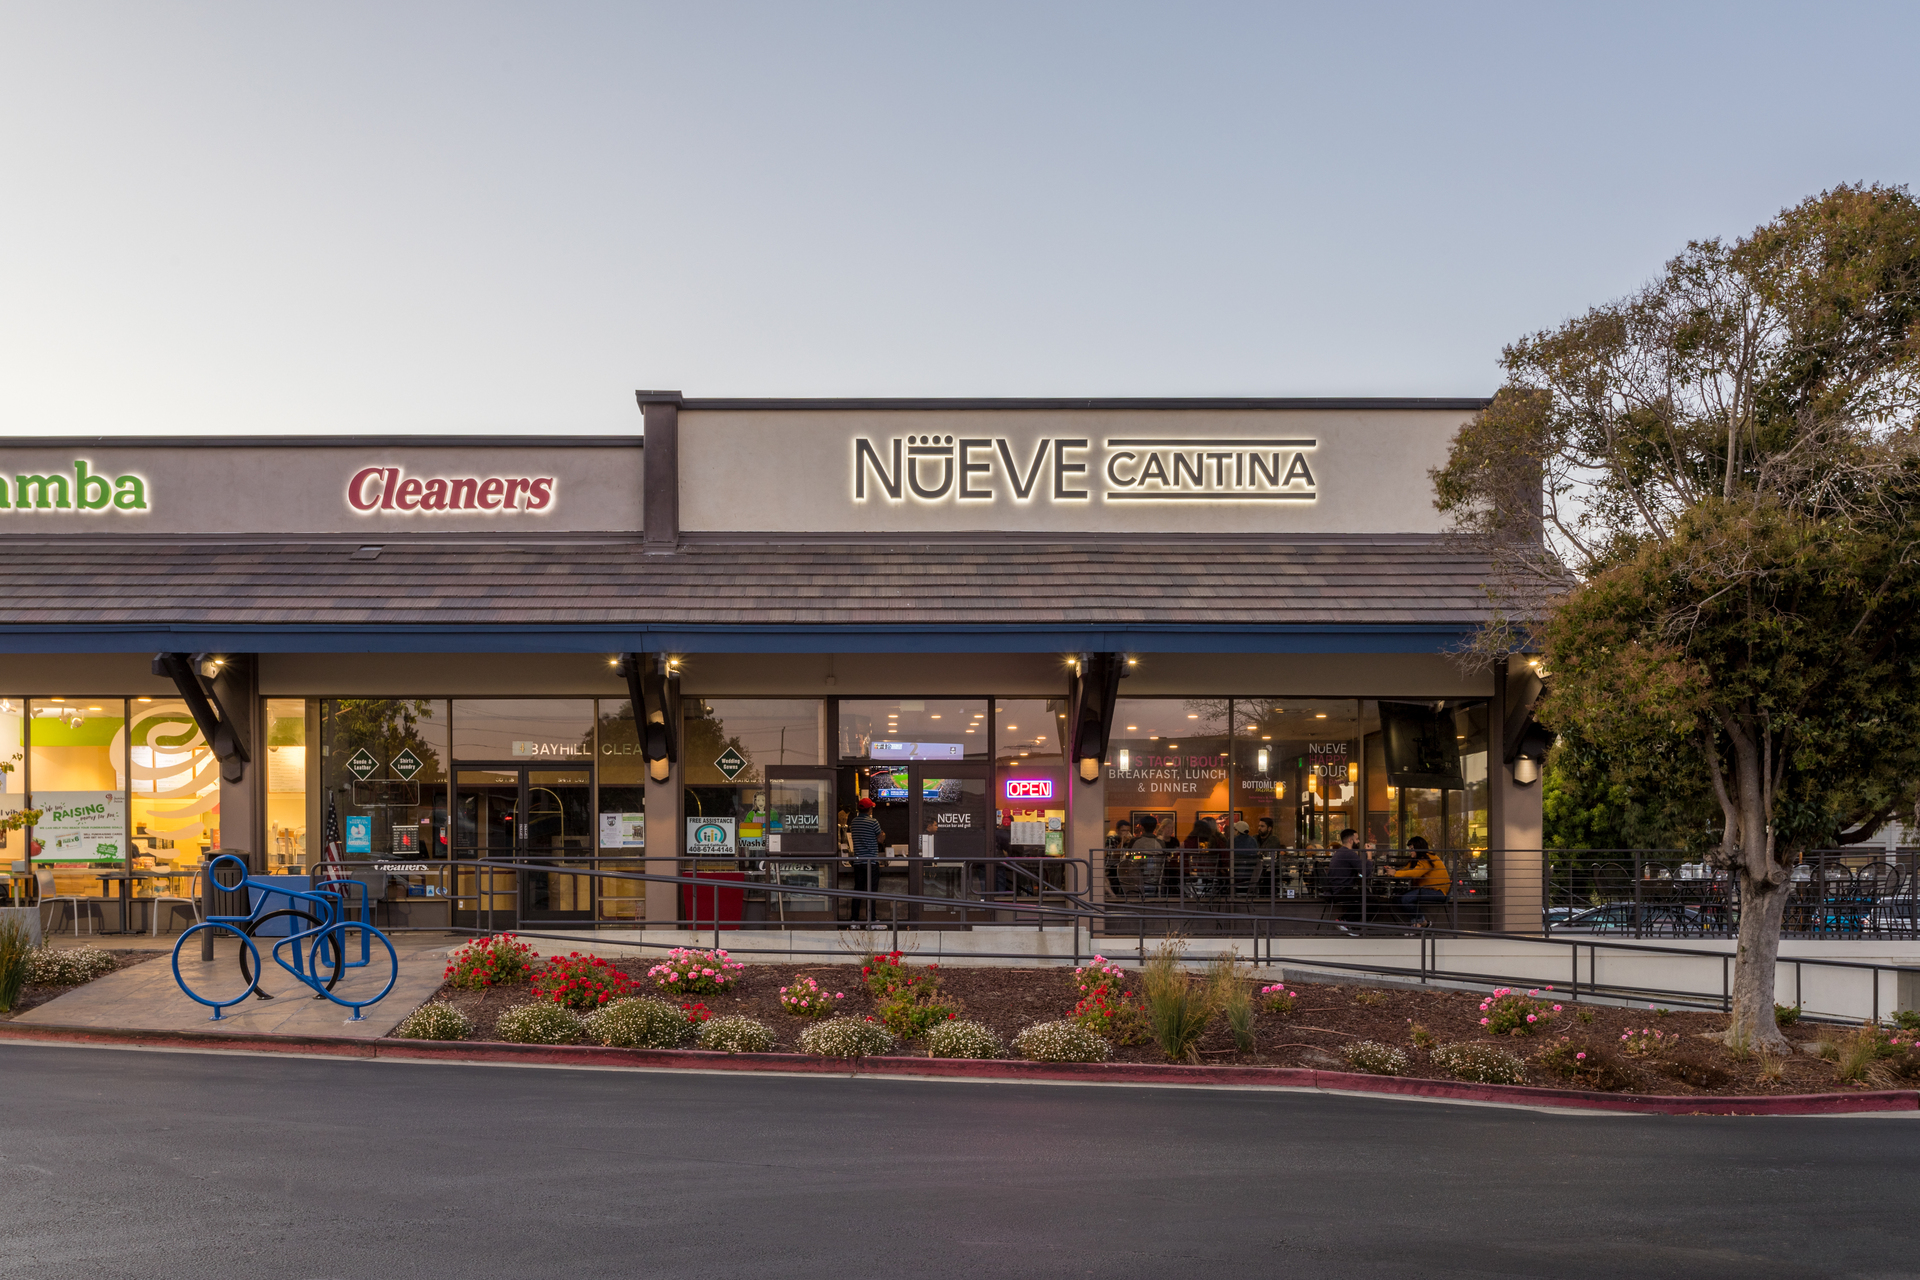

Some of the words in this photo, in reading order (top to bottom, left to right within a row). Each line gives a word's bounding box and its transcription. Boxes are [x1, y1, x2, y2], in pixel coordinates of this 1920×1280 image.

[1107, 452, 1316, 487] CANTINA
[348, 467, 554, 511] Cleaners
[532, 743, 592, 755] BAYHILL
[909, 743, 918, 756] 2
[1147, 756, 1180, 767] TACO
[1185, 756, 1226, 767] 'BOUT
[1309, 755, 1347, 765] HAPPY
[1109, 769, 1180, 780] BREAKFAST,
[1186, 769, 1226, 779] LUNCH
[1309, 765, 1347, 777] HOUR
[1009, 782, 1049, 796] OPEN
[1138, 782, 1145, 792] &
[1151, 783, 1197, 792] DINNER
[53, 804, 105, 821] RAISING
[739, 839, 758, 847] Wash
